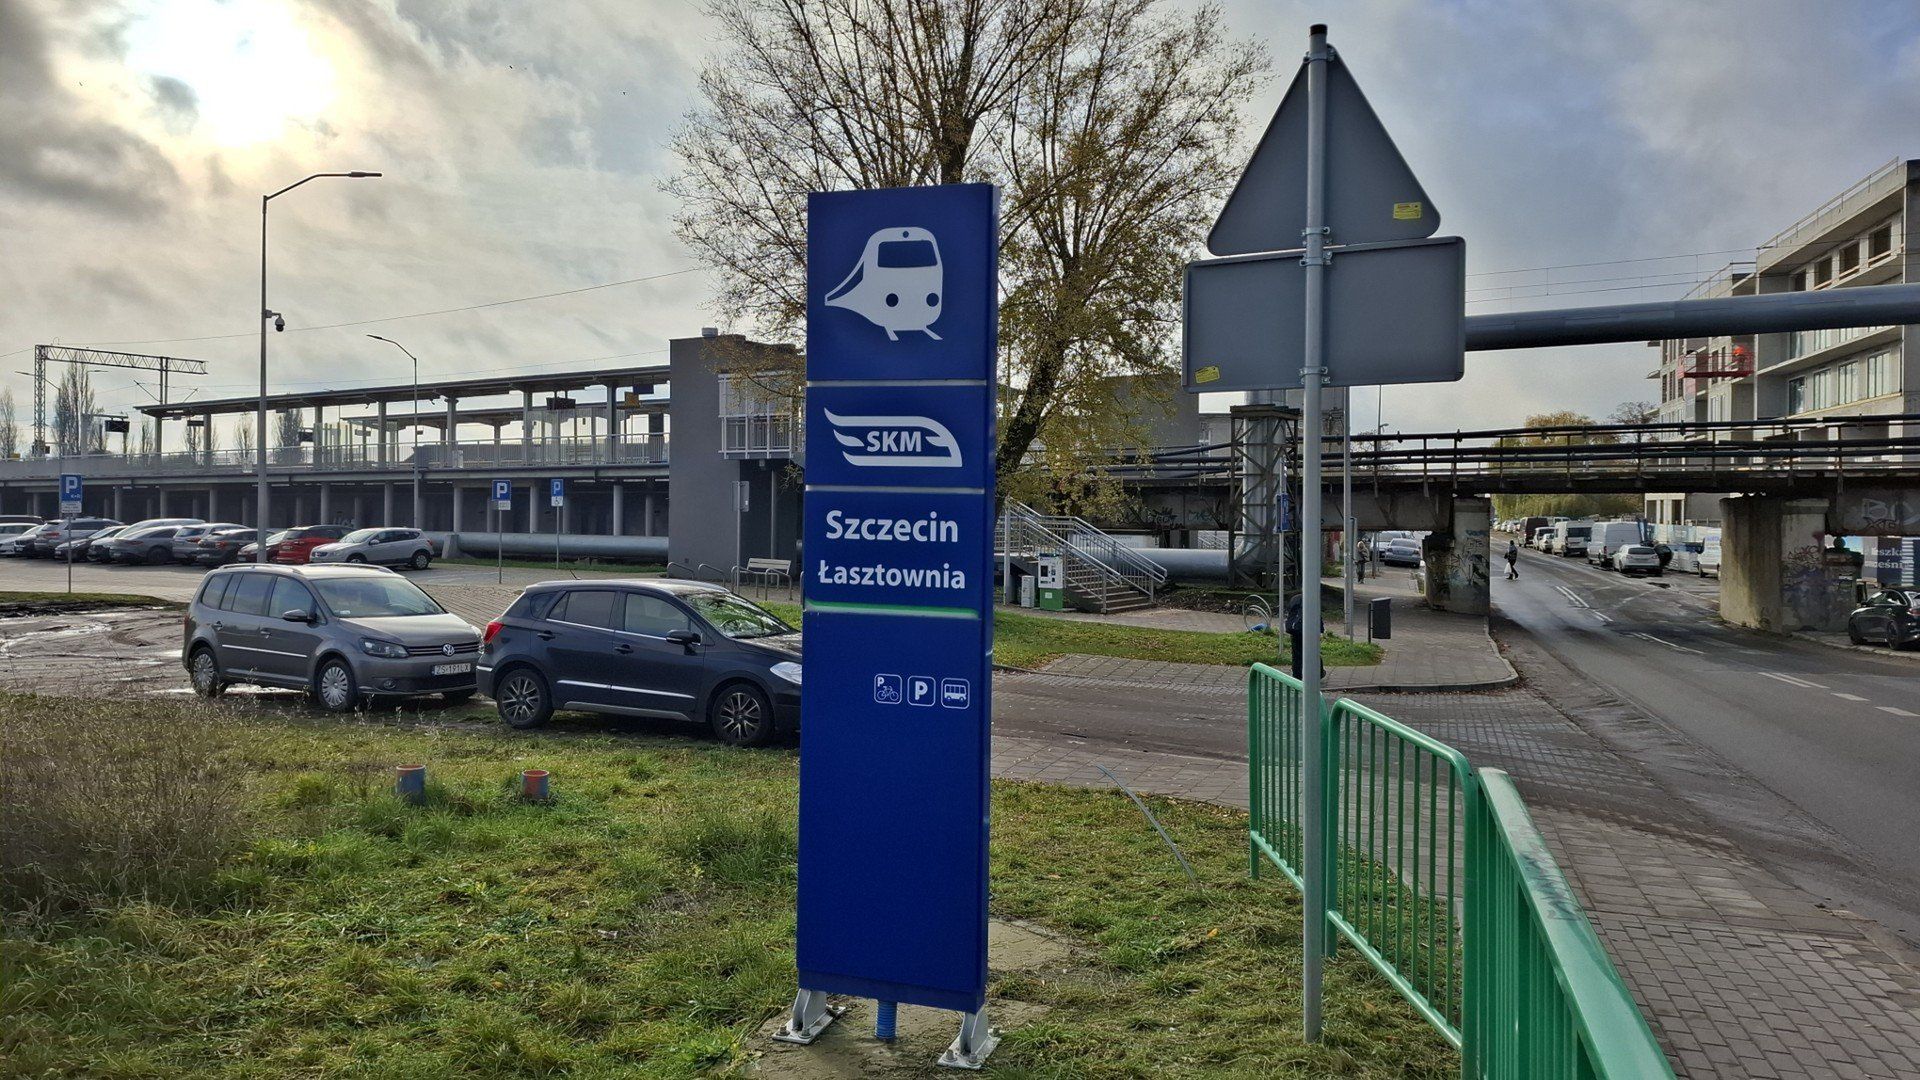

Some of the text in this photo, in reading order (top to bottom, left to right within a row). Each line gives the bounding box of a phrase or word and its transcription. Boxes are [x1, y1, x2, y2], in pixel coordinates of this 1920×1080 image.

[866, 431, 922, 452] SKM
[66, 476, 78, 493] P
[496, 482, 508, 498] P
[553, 481, 561, 495] P
[825, 510, 958, 542] Szczecin
[818, 559, 965, 589] Łasztownia
[877, 676, 885, 687] P
[914, 680, 928, 700] P
